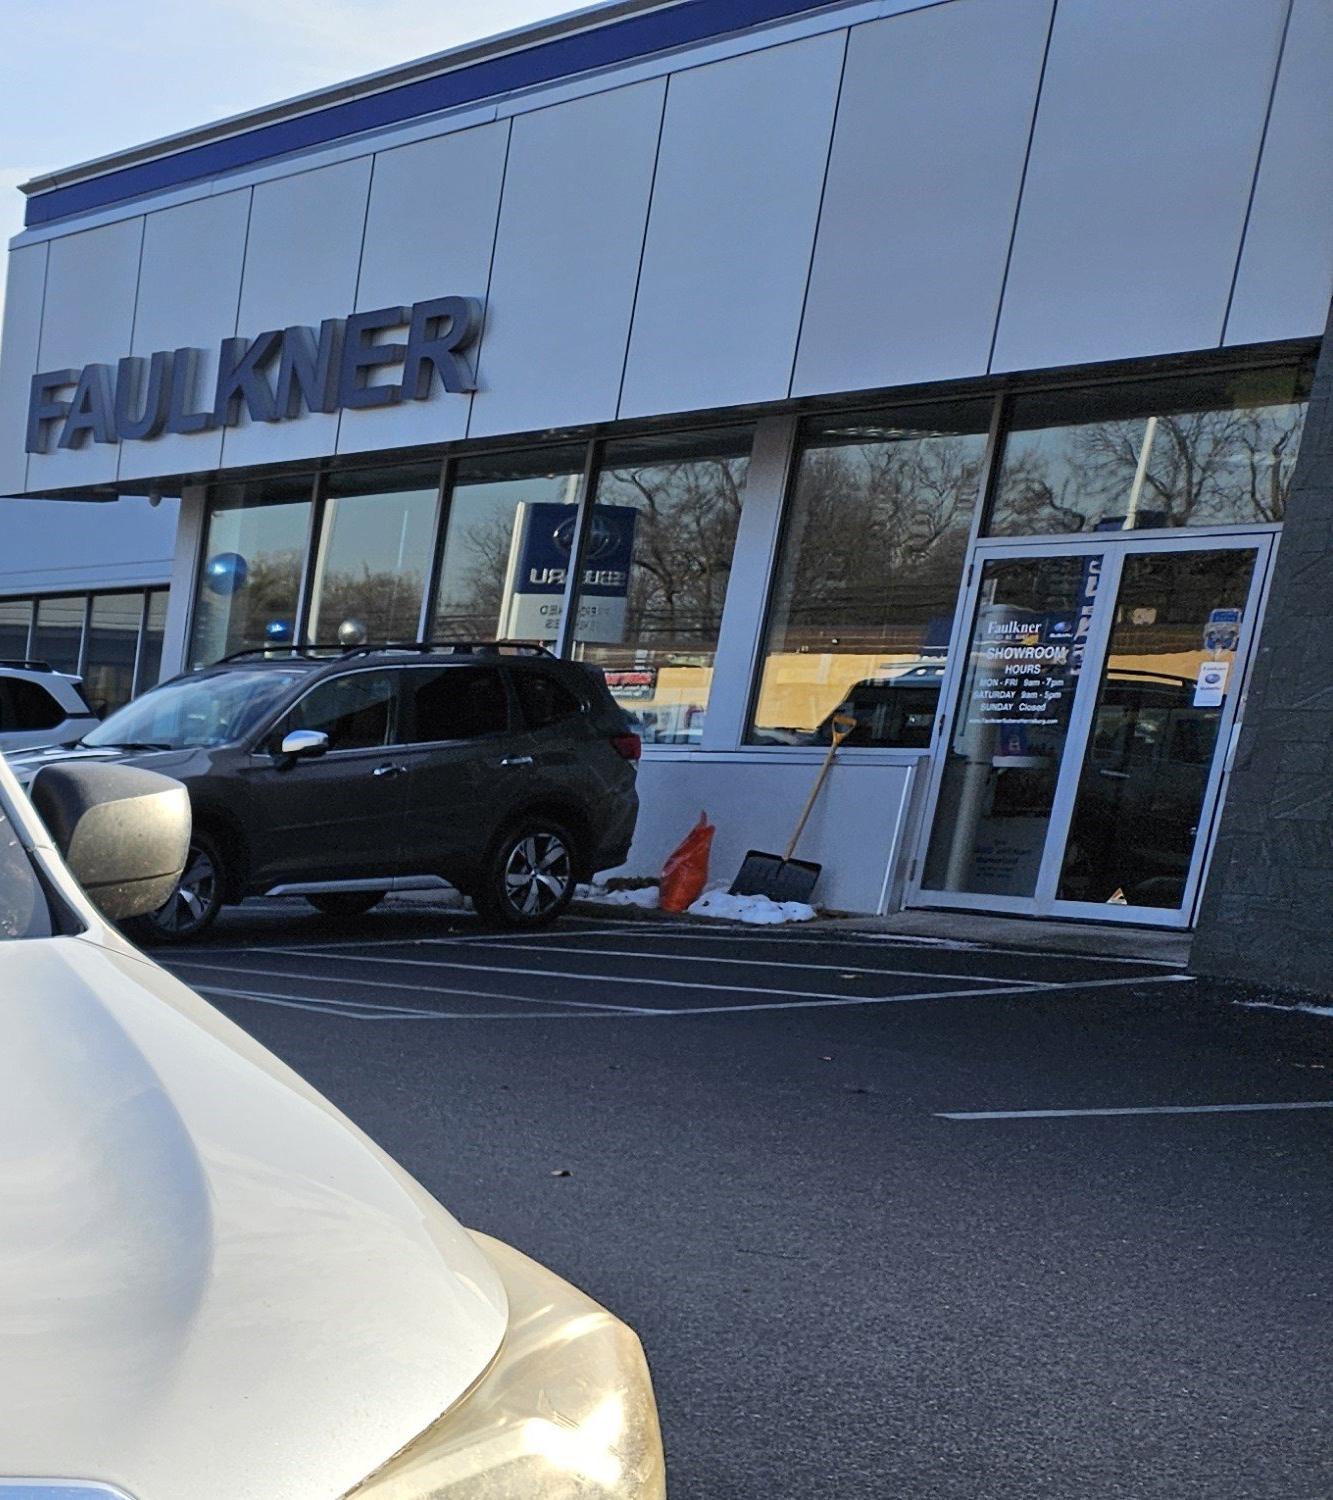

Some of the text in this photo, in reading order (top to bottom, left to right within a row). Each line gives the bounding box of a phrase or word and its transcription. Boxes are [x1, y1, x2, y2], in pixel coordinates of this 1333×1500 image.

[25, 296, 480, 454] FAULKNER
[987, 621, 1042, 634] Faulkner
[986, 646, 1066, 660] SHOWROOM
[1005, 664, 1041, 674] HOURS
[1004, 678, 1019, 687] FRI
[973, 690, 1016, 699] SATURDAY
[980, 702, 1046, 711] SUNDAY Closed
